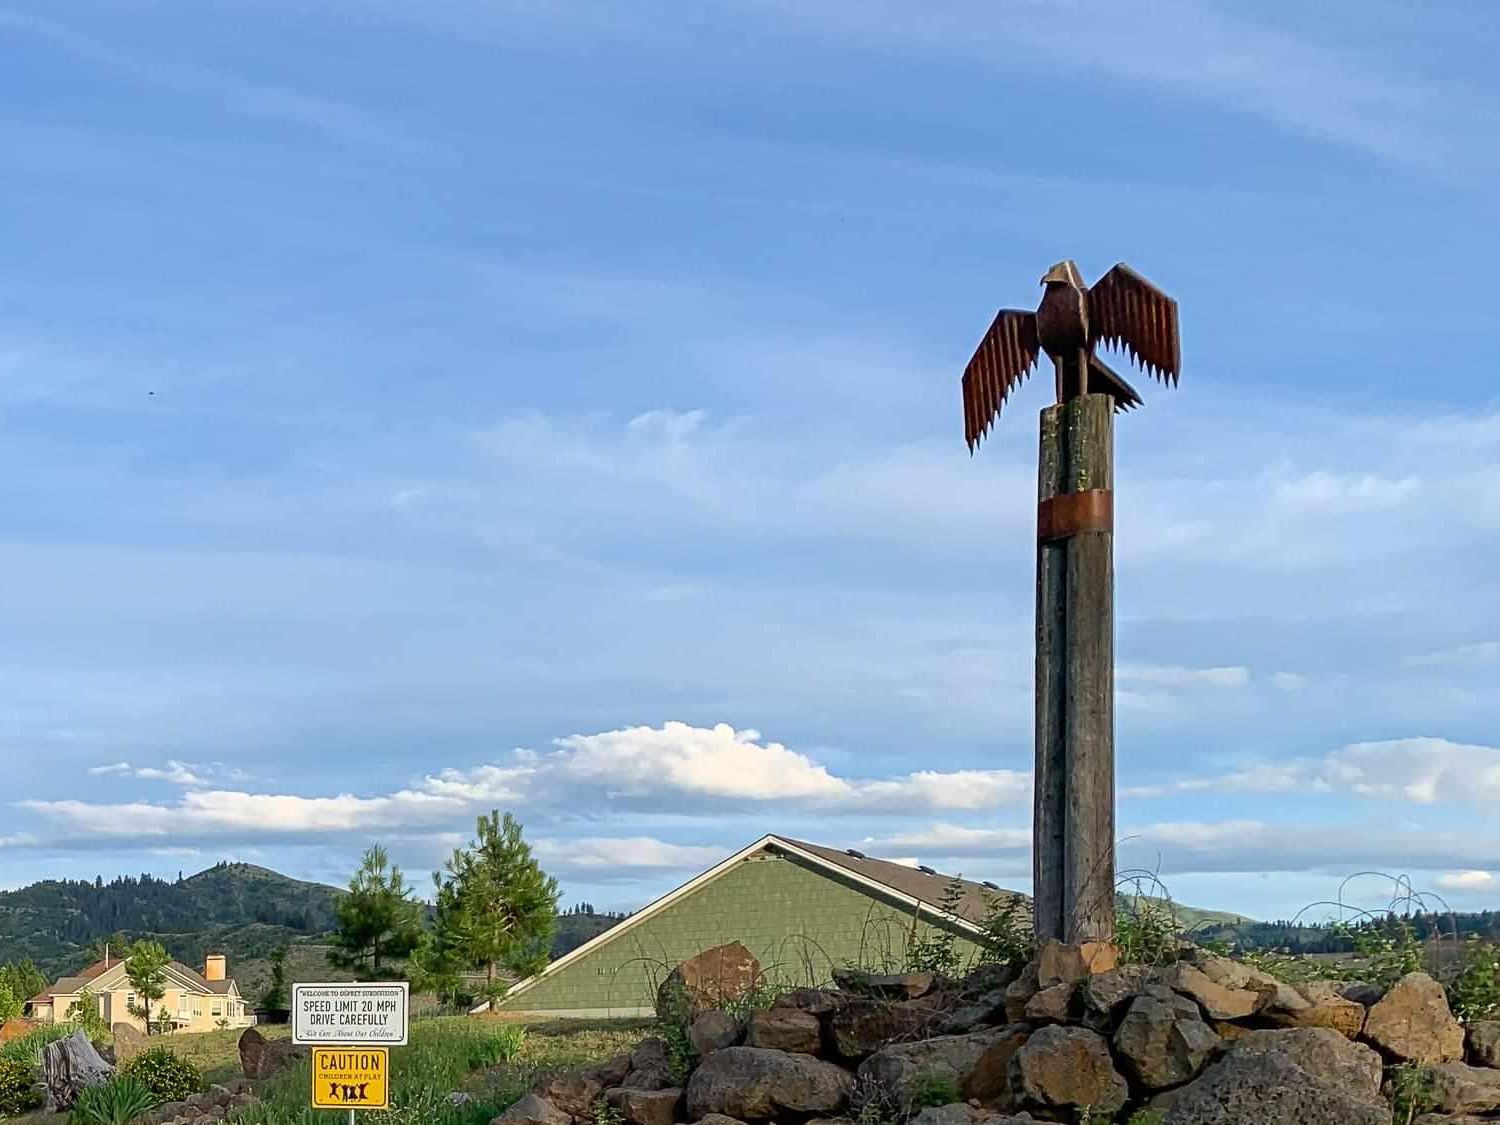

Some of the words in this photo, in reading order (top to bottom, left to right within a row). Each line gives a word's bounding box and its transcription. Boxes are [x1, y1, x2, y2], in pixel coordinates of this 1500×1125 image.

[303, 1000, 331, 1012] SPEED
[335, 1000, 358, 1012] LIMIT
[362, 1000, 373, 1012] 20
[377, 1000, 396, 1012] MPH
[310, 1014, 335, 1025] DRIVE
[340, 1014, 388, 1025] CAREFULLY
[321, 1054, 379, 1070] CAUTION
